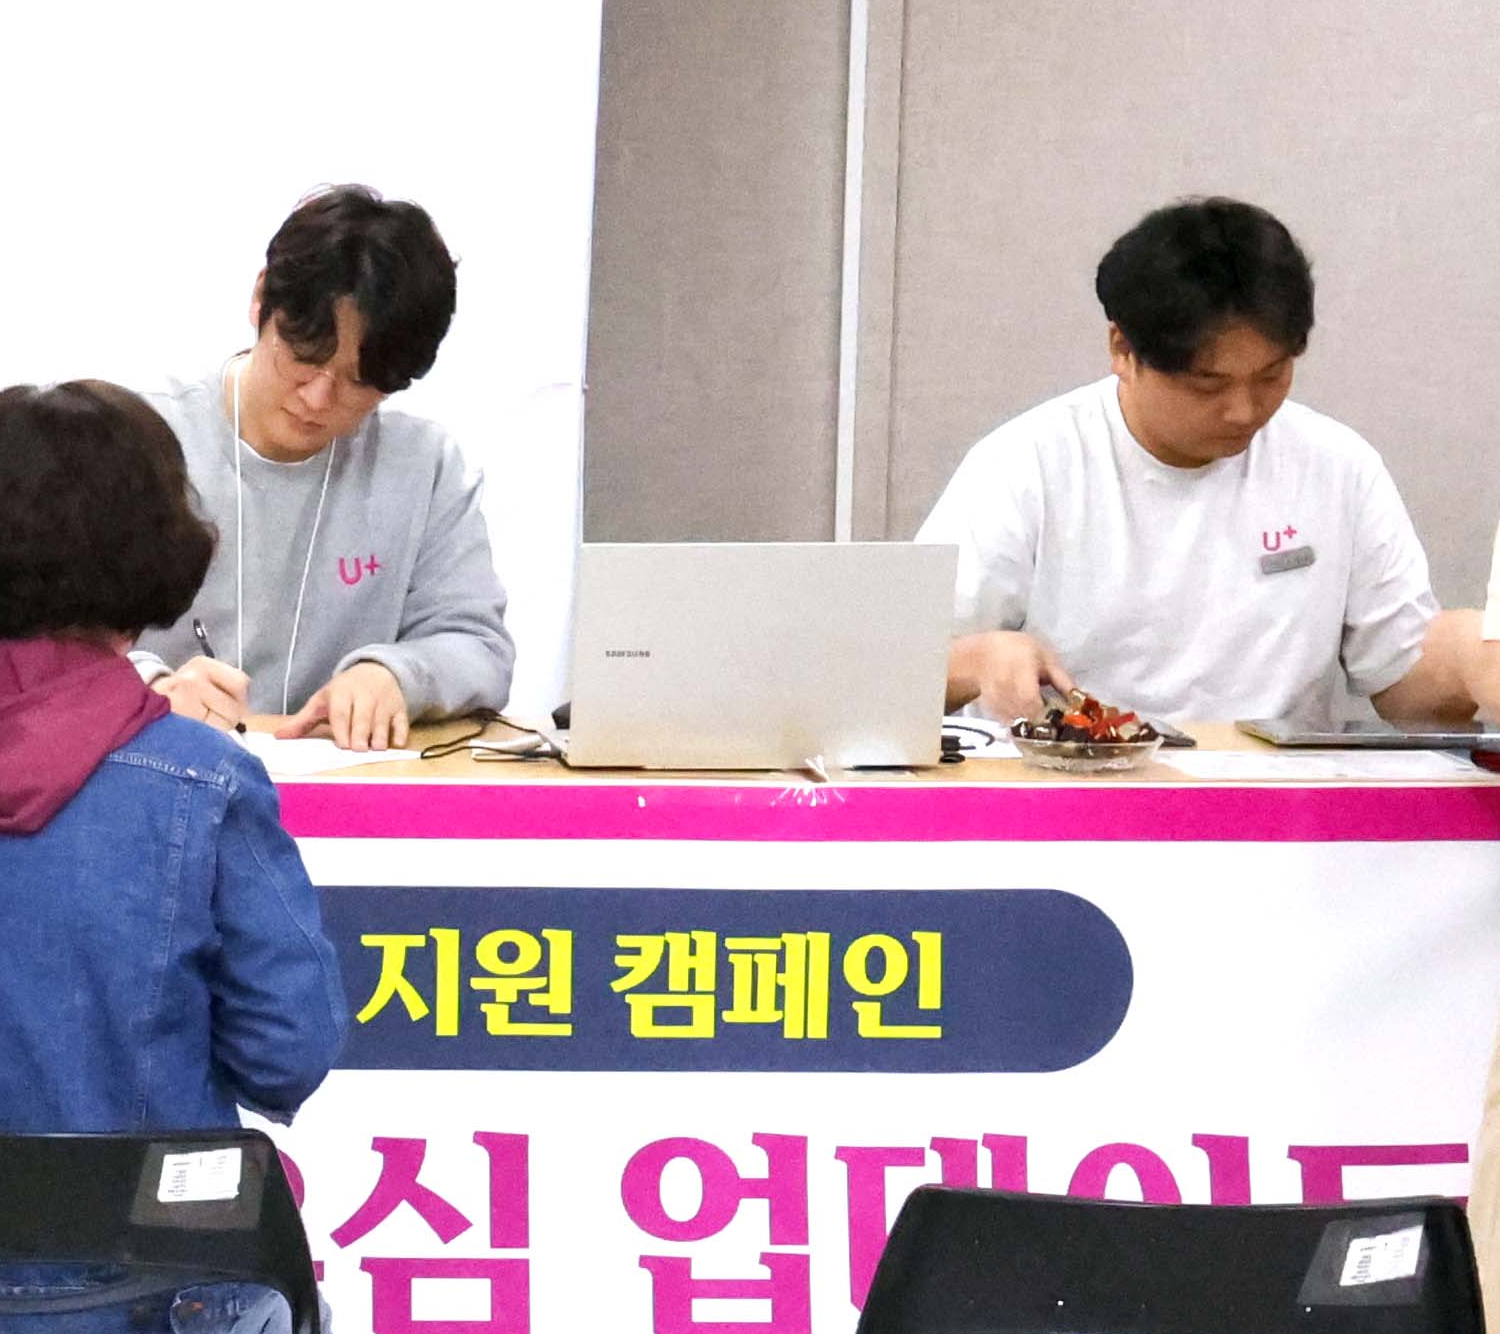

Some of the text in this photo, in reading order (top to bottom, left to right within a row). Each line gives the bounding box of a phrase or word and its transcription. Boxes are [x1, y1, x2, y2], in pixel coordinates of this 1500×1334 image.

[1264, 528, 1296, 548] U+
[339, 556, 379, 586] U+
[357, 929, 941, 1038] 지원 캠페인
